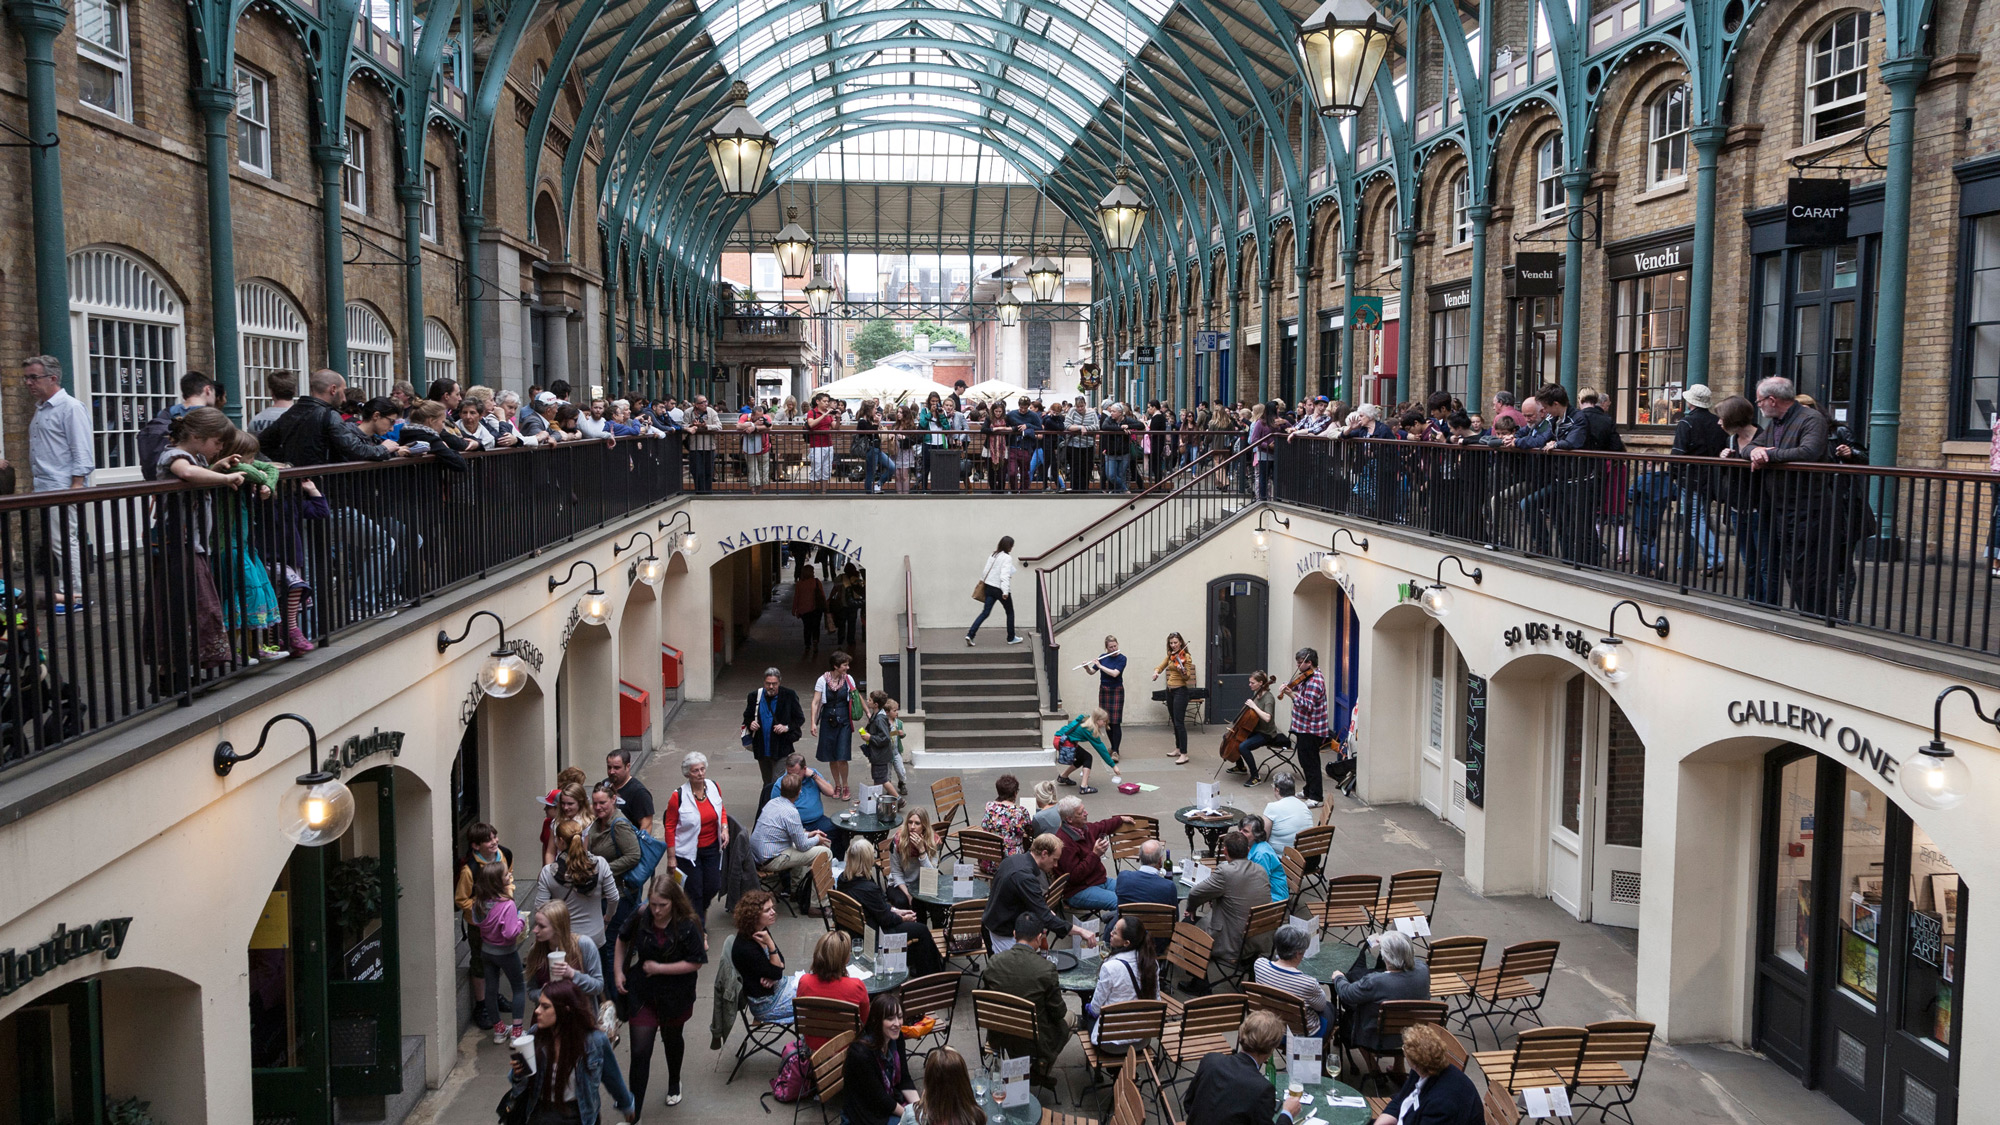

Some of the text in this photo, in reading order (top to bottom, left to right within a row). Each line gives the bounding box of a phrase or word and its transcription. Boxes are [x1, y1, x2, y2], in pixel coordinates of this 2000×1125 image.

[1634, 245, 1680, 272] Venchi
[1521, 270, 1553, 279] Venchi
[1443, 289, 1470, 308] Venchi
[718, 525, 864, 562] NAUTICALIA
[1727, 700, 1900, 784] GALLERY ONE
[1914, 912, 1940, 934] NEW
[0, 916, 133, 997] hutney
[1912, 940, 1939, 962] ART
